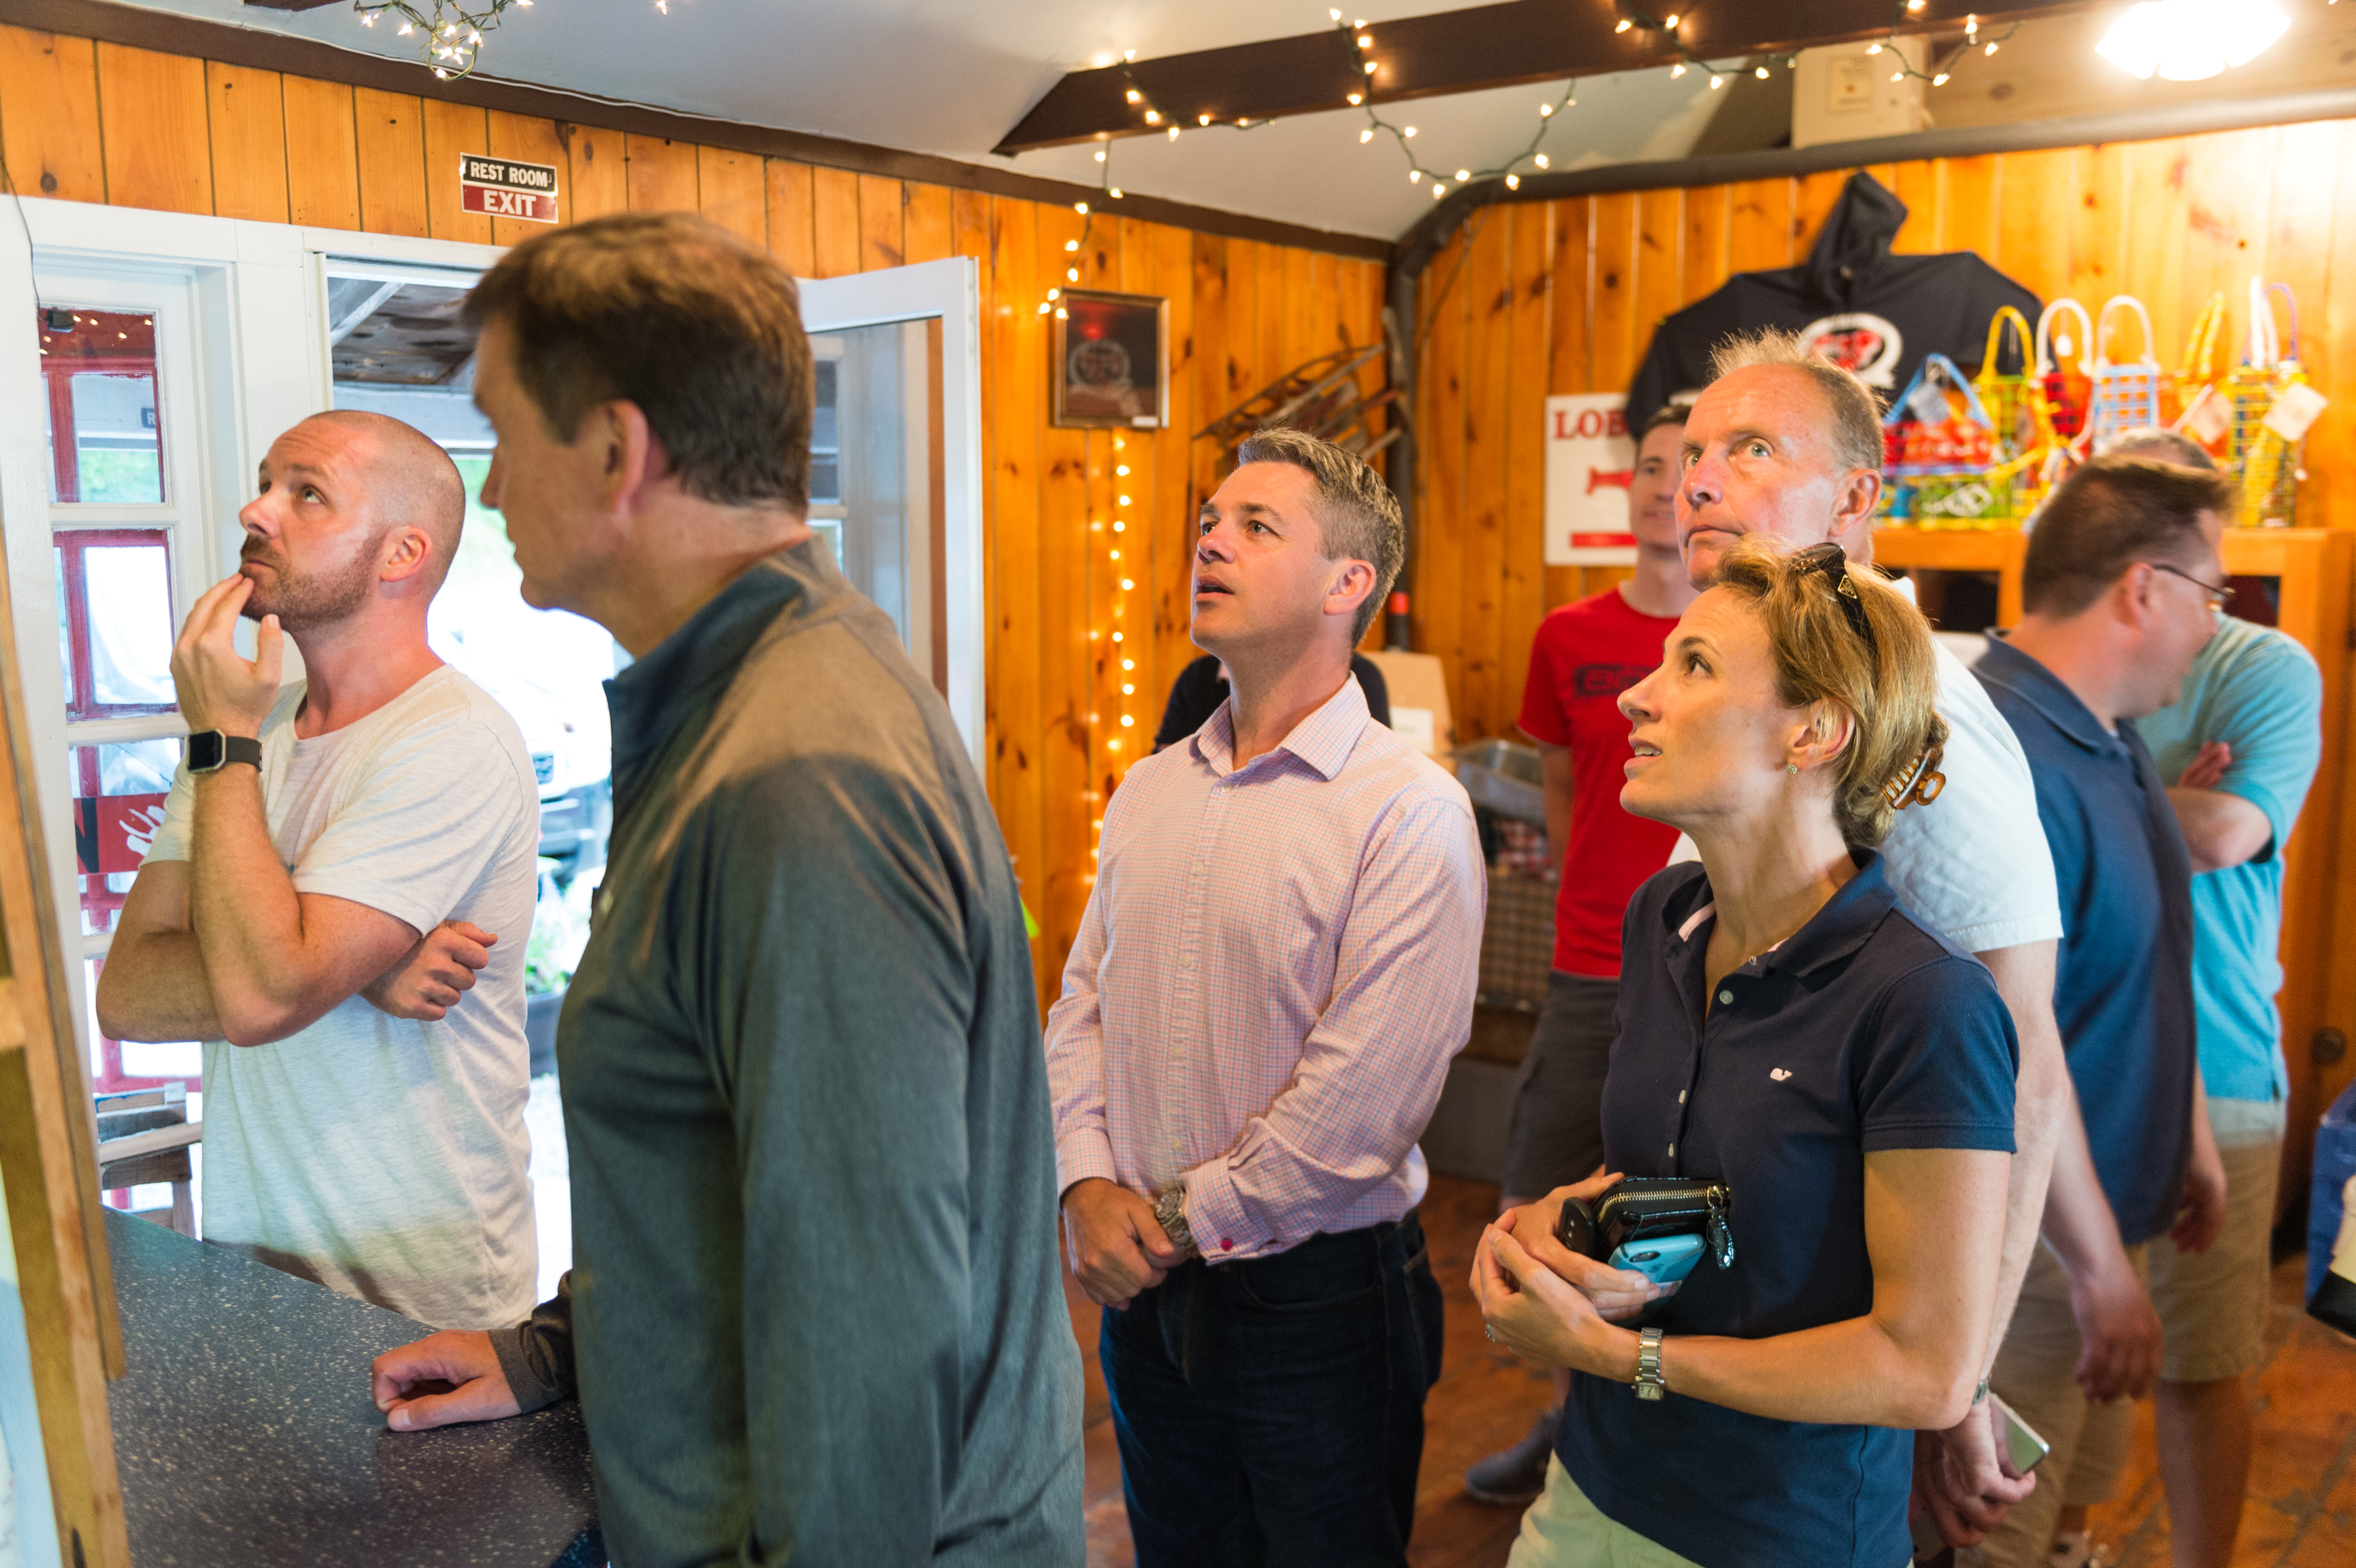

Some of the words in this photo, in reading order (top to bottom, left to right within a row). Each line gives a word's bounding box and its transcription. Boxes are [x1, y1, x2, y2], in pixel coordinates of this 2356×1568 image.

[470, 161, 504, 181] REST
[509, 167, 548, 187] ROOM
[483, 189, 536, 216] EXIT
